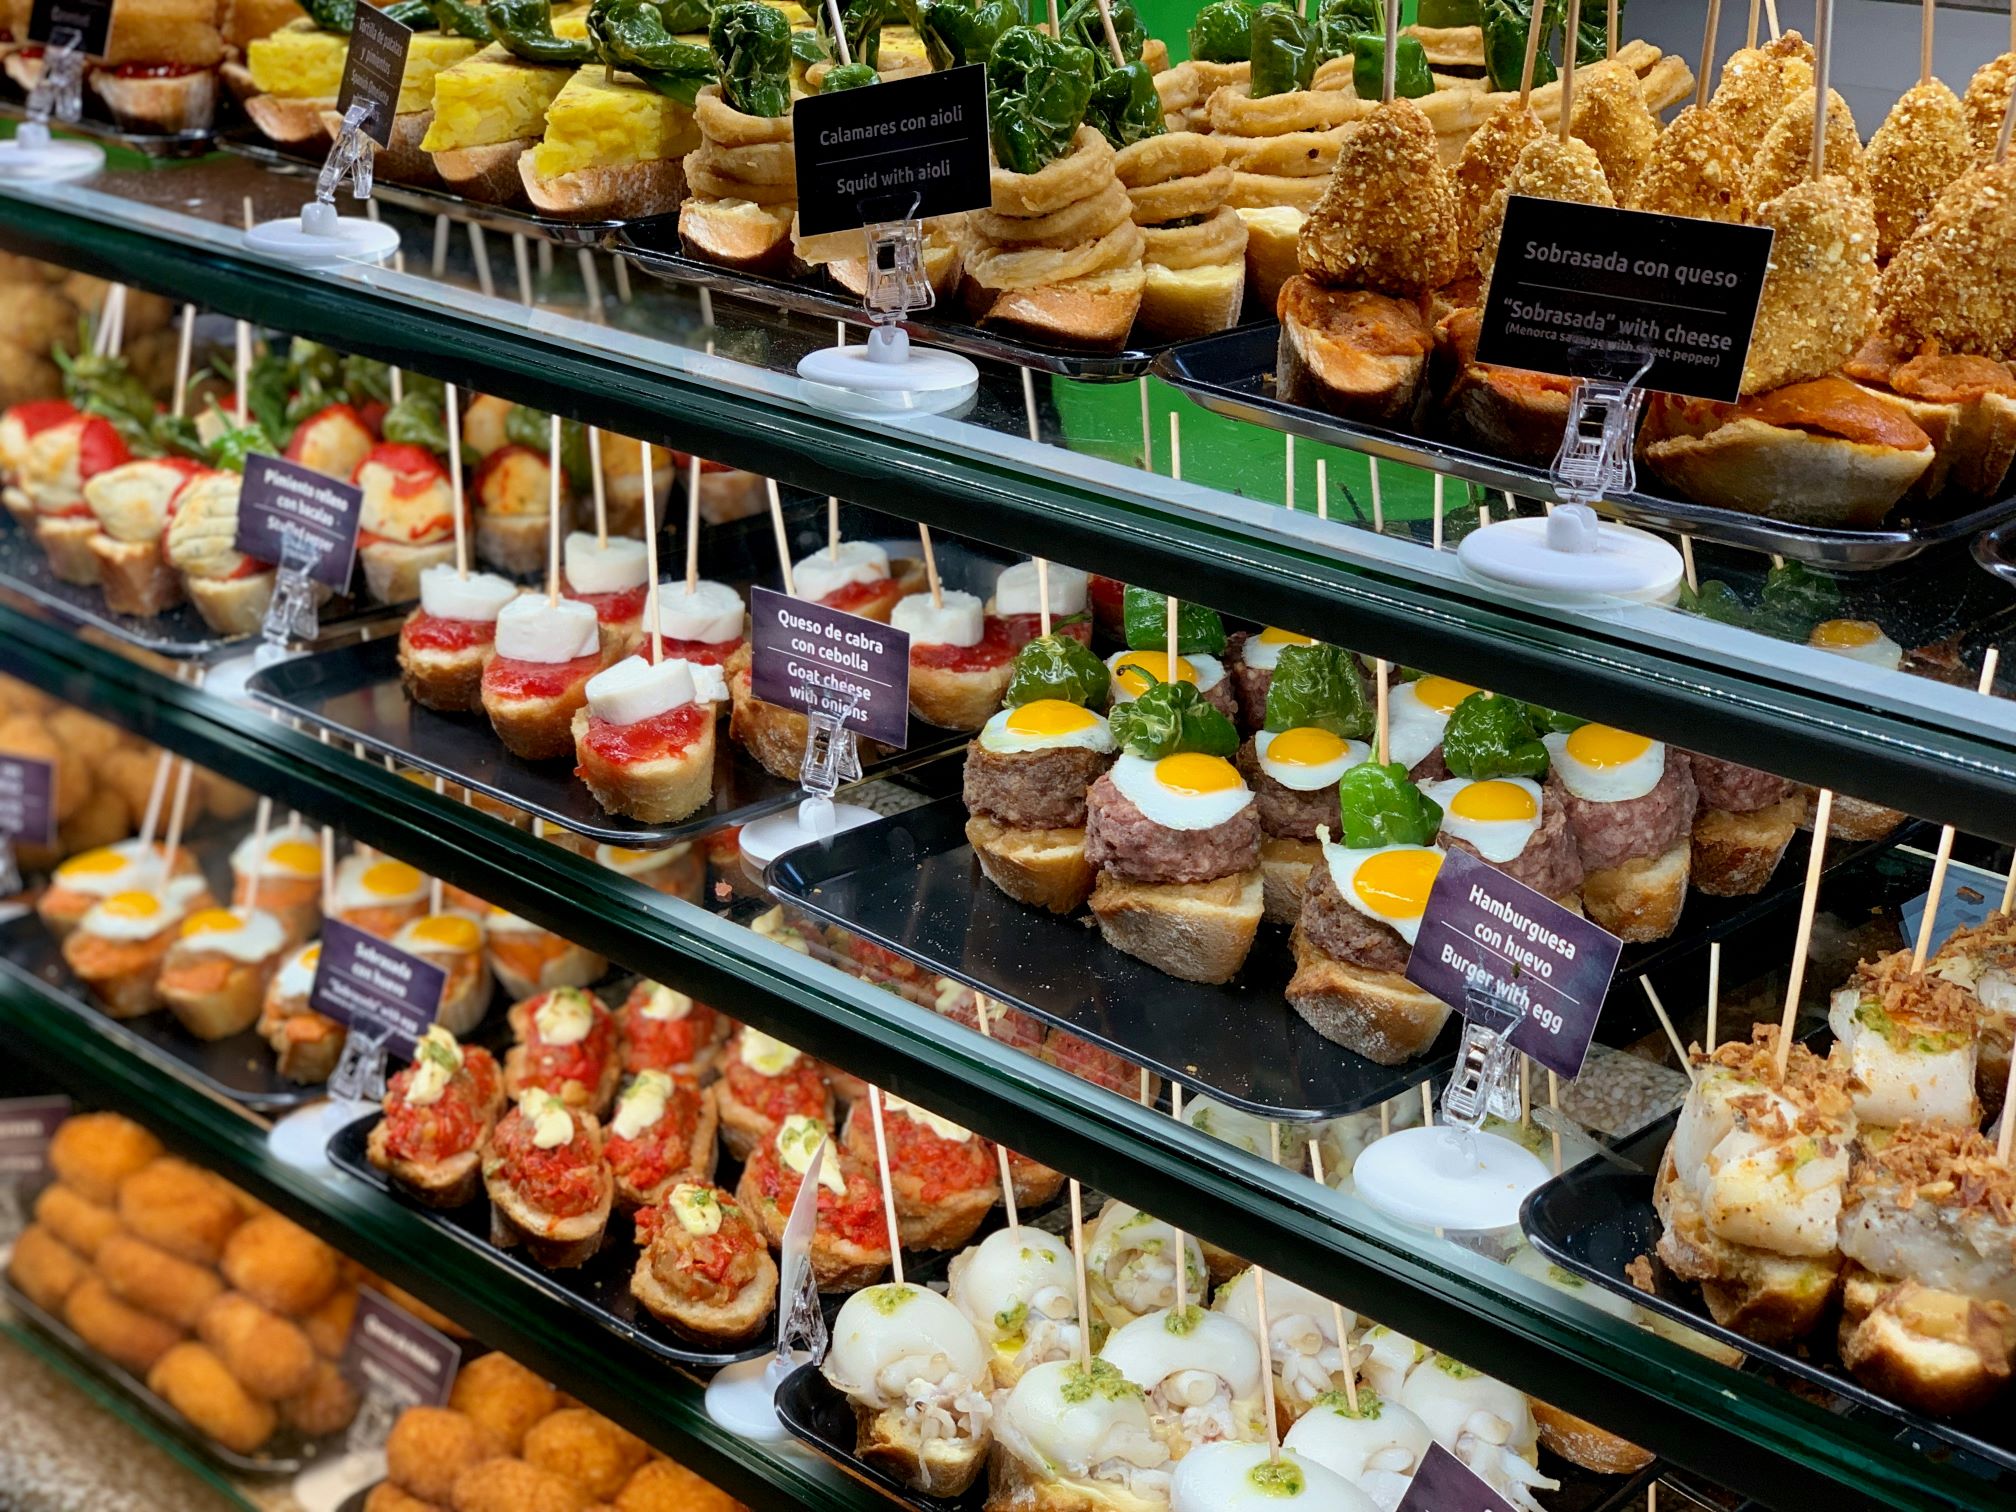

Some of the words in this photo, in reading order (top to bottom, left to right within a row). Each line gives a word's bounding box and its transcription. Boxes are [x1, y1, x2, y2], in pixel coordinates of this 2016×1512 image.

[820, 121, 896, 146] Calamares
[900, 116, 926, 132] con
[930, 105, 962, 126] aioli
[837, 172, 877, 195] Squid
[881, 166, 914, 187] with
[918, 159, 950, 180] aioli
[1524, 240, 1628, 273] Sobrasada
[1633, 259, 1669, 278] con
[1675, 265, 1738, 288] queso
[1505, 322, 1557, 341] (Menorca
[1672, 350, 1720, 368] pepper)
[1618, 318, 1660, 339] with
[1664, 324, 1733, 351] cheese
[276, 495, 298, 512] con
[778, 609, 822, 635] Queso
[825, 623, 842, 641] de
[845, 632, 884, 654] cabra
[791, 638, 815, 655] con
[818, 645, 869, 672] cebolla
[787, 661, 820, 686] Goat
[823, 673, 872, 701] cheese
[789, 685, 818, 705] with
[821, 697, 868, 722] onions
[1468, 884, 1577, 960] Hamburguesa
[1474, 922, 1502, 949] con
[1503, 936, 1553, 978] huevo
[1440, 943, 1494, 987] Burger
[1495, 977, 1530, 1010] with
[1532, 1003, 1563, 1035] egg
